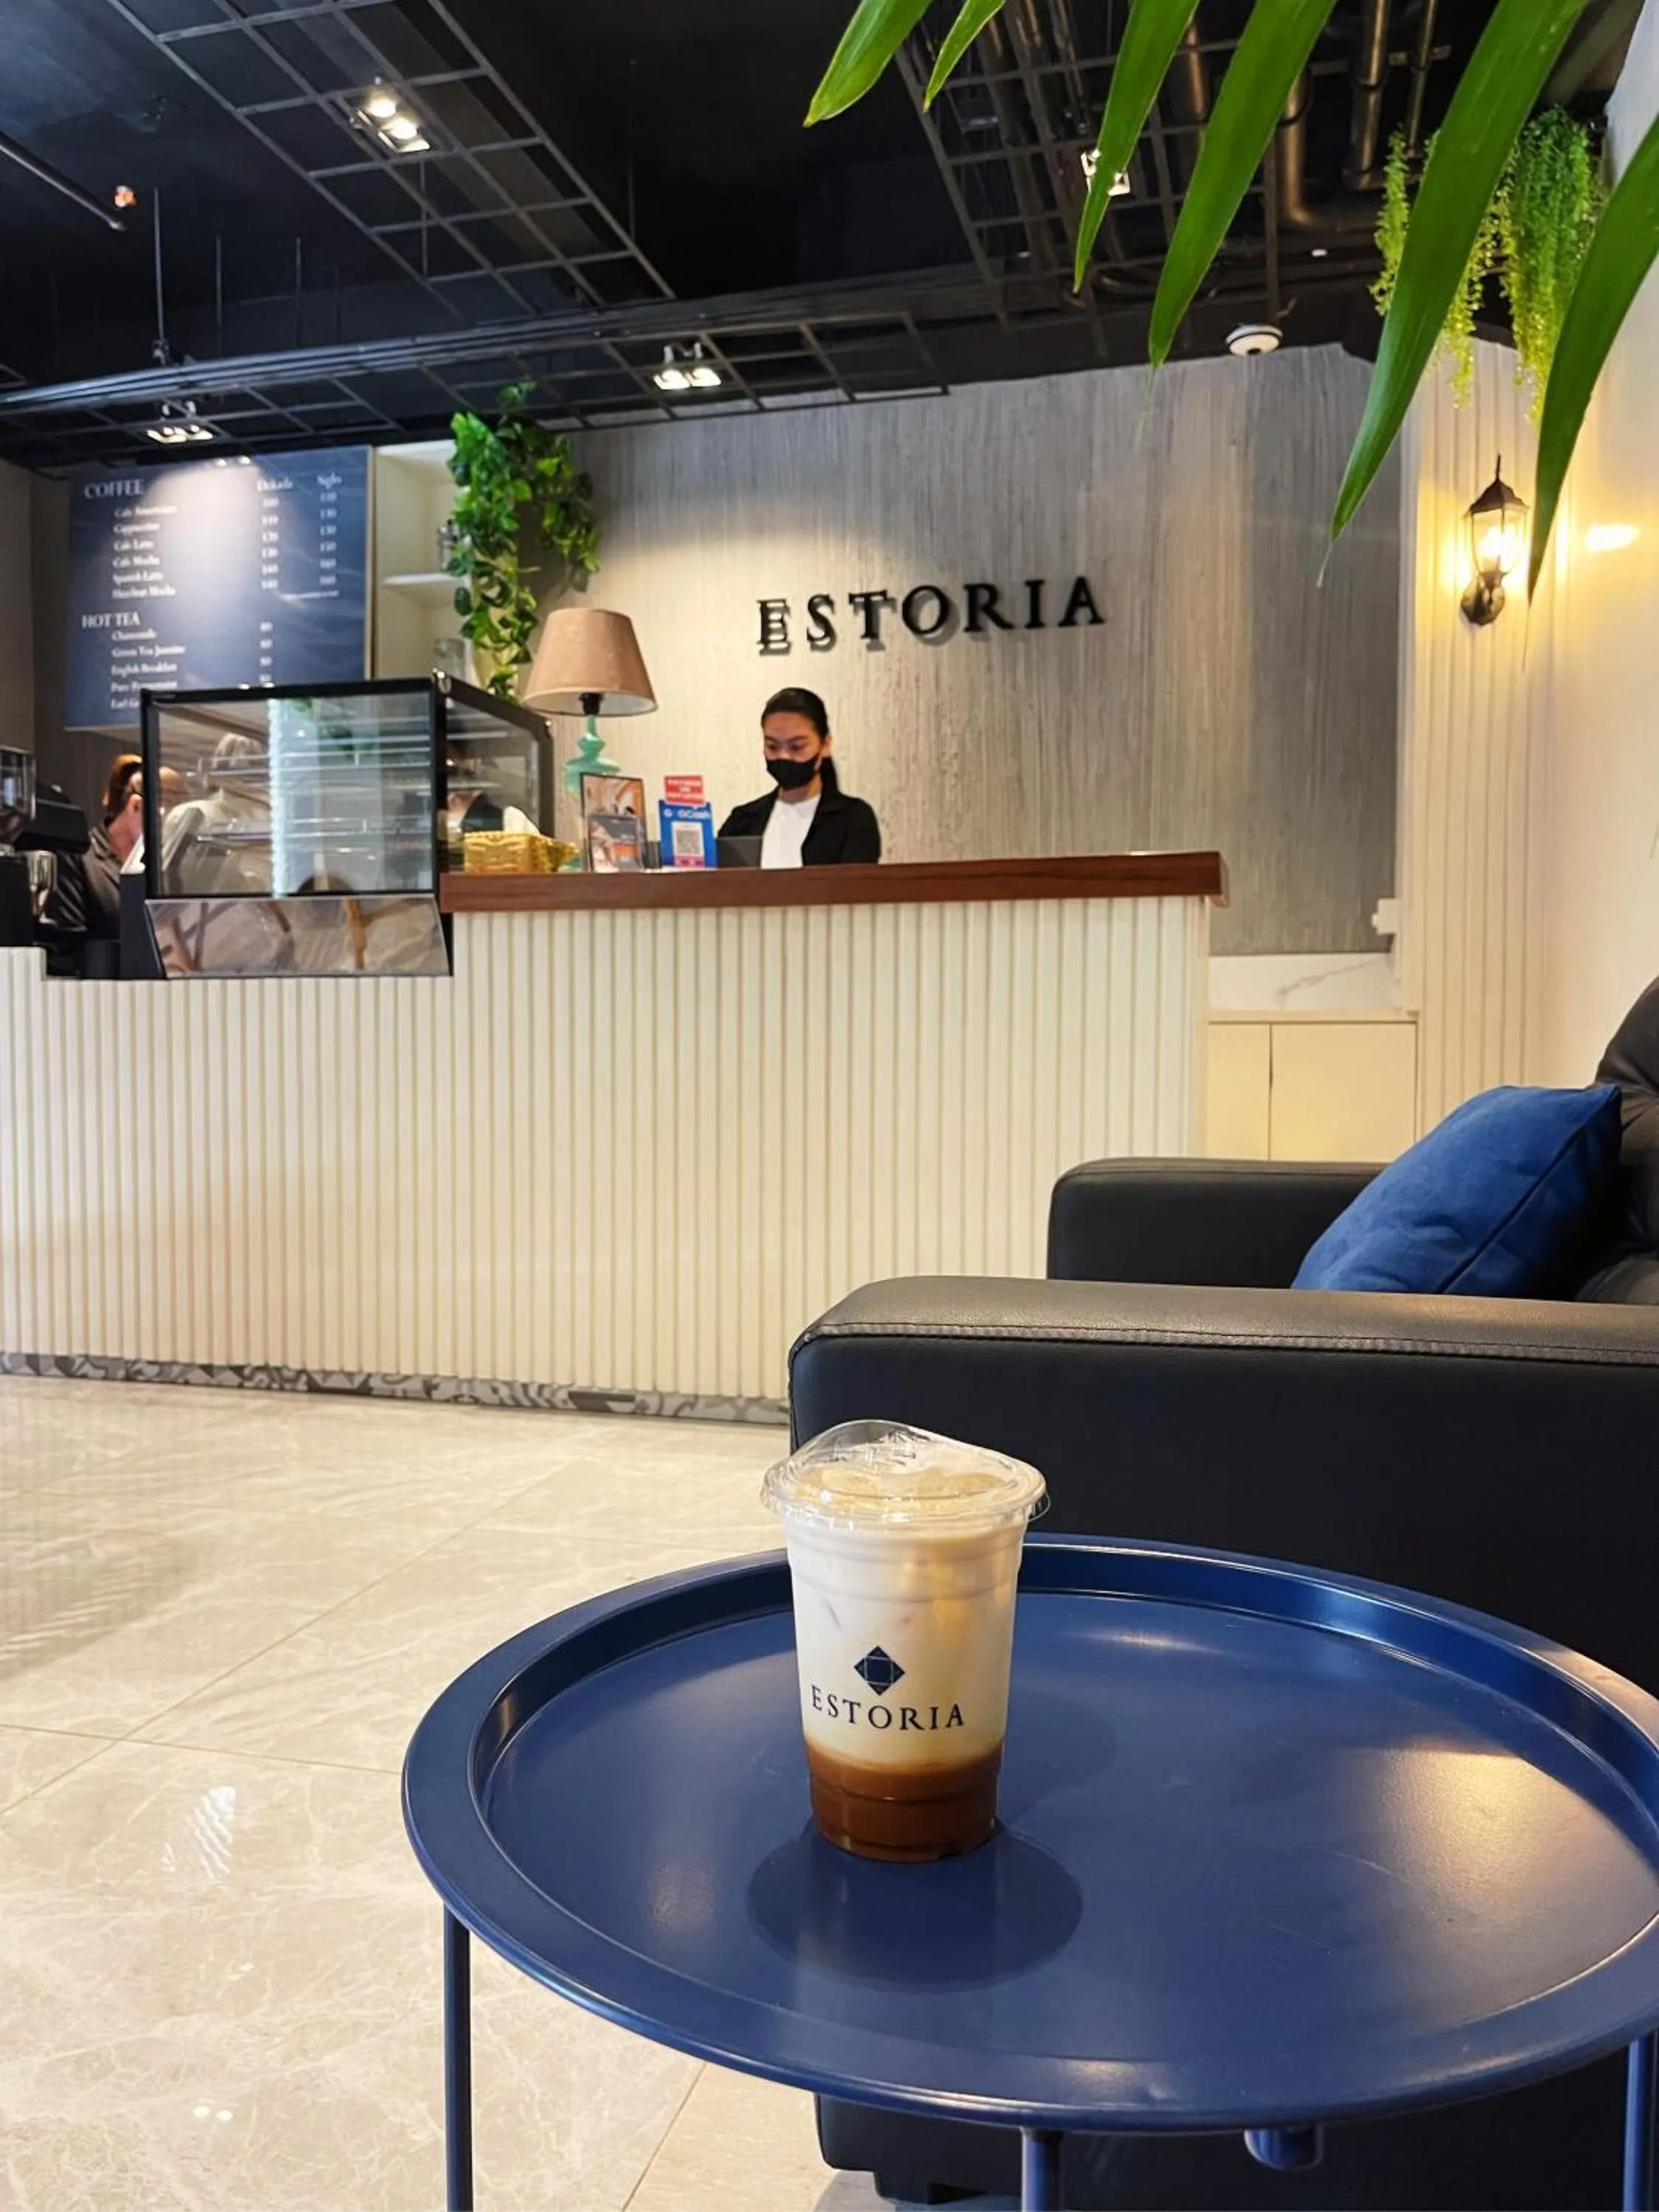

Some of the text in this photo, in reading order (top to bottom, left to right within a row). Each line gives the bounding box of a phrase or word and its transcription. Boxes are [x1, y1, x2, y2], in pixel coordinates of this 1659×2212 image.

[83, 479, 145, 498] COFFEE
[82, 611, 141, 628] HOT TEA
[756, 575, 1105, 647] ESTORIA
[811, 1684, 964, 1731] ESTORIA
